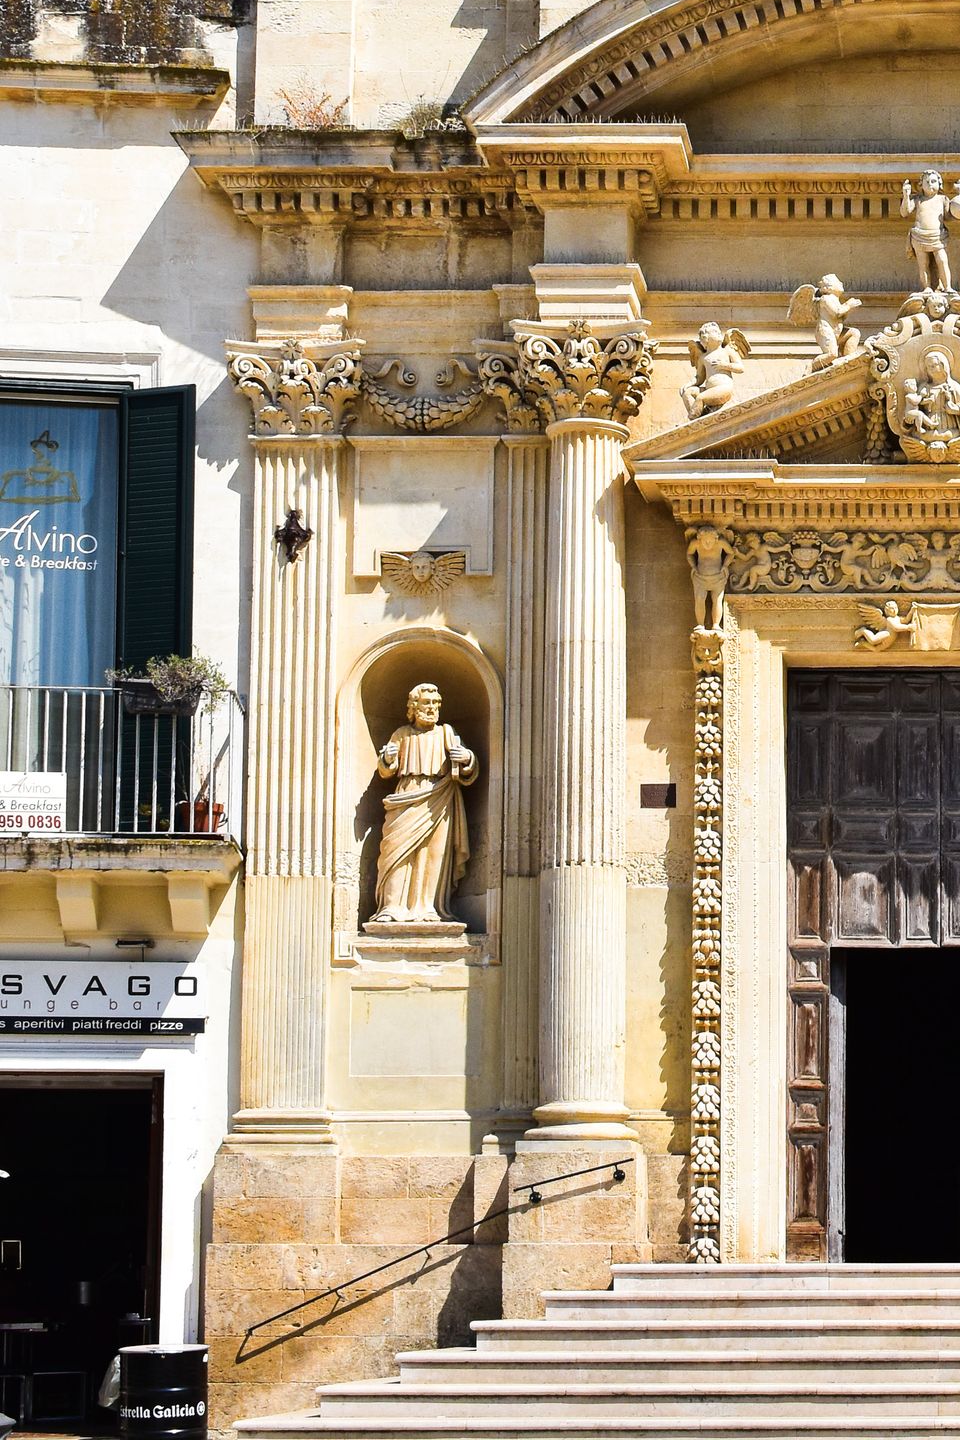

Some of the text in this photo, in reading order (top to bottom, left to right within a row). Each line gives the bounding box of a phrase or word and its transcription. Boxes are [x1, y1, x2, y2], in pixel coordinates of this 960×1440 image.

[0, 509, 98, 554] Alvino
[15, 554, 26, 567] &
[31, 555, 99, 570] Breakfast
[10, 800, 62, 811] Breakfast
[28, 815, 62, 829] 0836
[1, 974, 198, 997] SVAGO
[109, 998, 161, 1011] bar
[14, 1019, 65, 1030] aperitivi
[72, 1019, 103, 1031] piatti
[106, 1019, 142, 1030] freddi
[149, 1020, 184, 1031] pizze
[153, 1403, 196, 1419] Galicia
